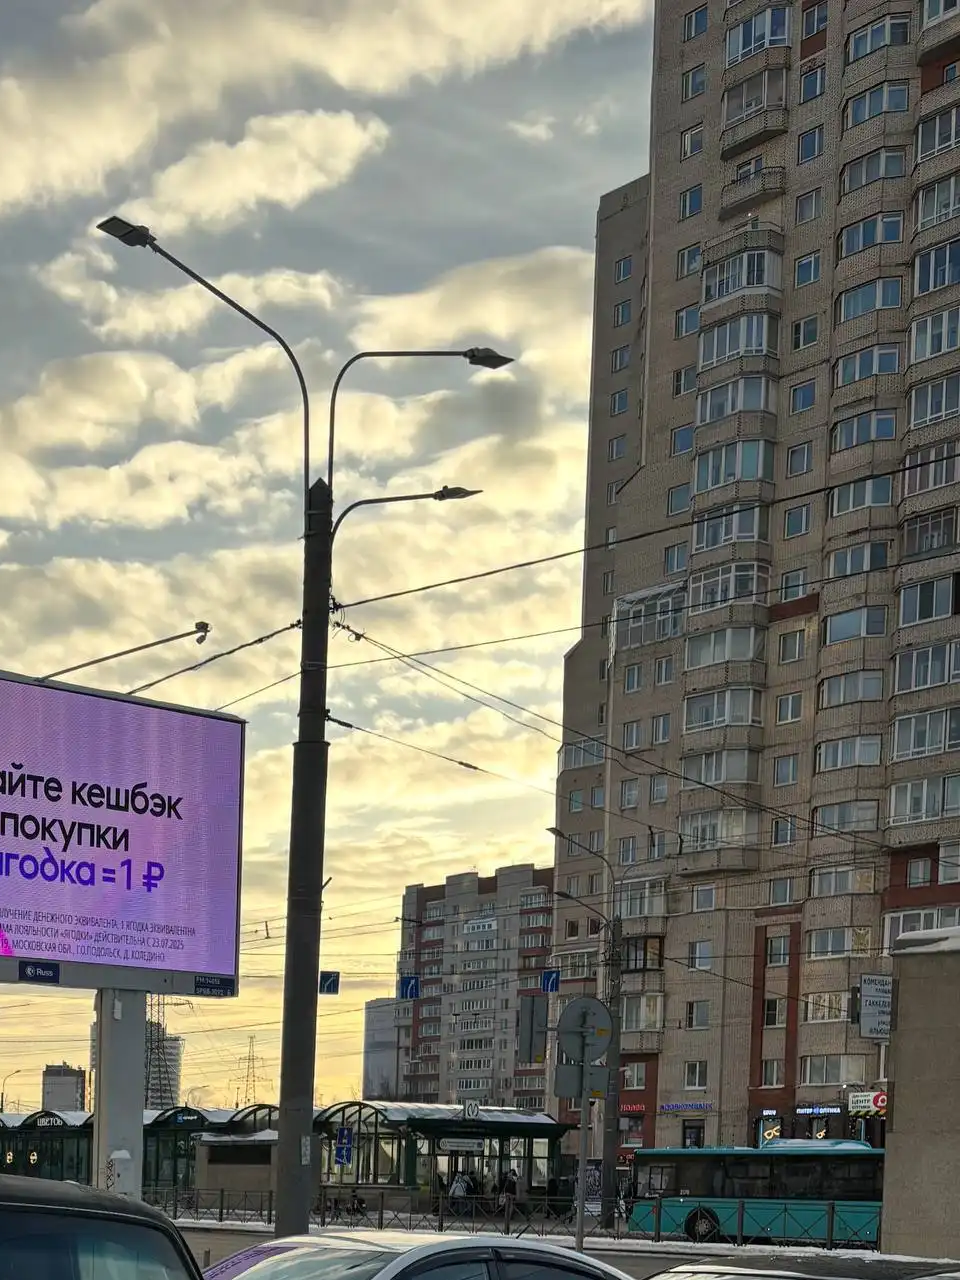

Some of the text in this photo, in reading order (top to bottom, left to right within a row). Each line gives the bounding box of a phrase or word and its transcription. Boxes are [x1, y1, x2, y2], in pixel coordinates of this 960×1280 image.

[71, 780, 184, 820] кешбэк
[0, 811, 131, 852] покупки
[142, 861, 166, 893] ₽
[14, 924, 59, 939] ЛОЯЛЬНОСТИ
[94, 931, 146, 947] ДЕЙСТВИТЕЛЬНА
[33, 911, 73, 925] ДЕНЕЖНОГО
[149, 922, 196, 937] ЭКВИВАЛЕНТНА
[12, 938, 57, 953] МОСКОВСКАЯ
[36, 967, 54, 977] Russ
